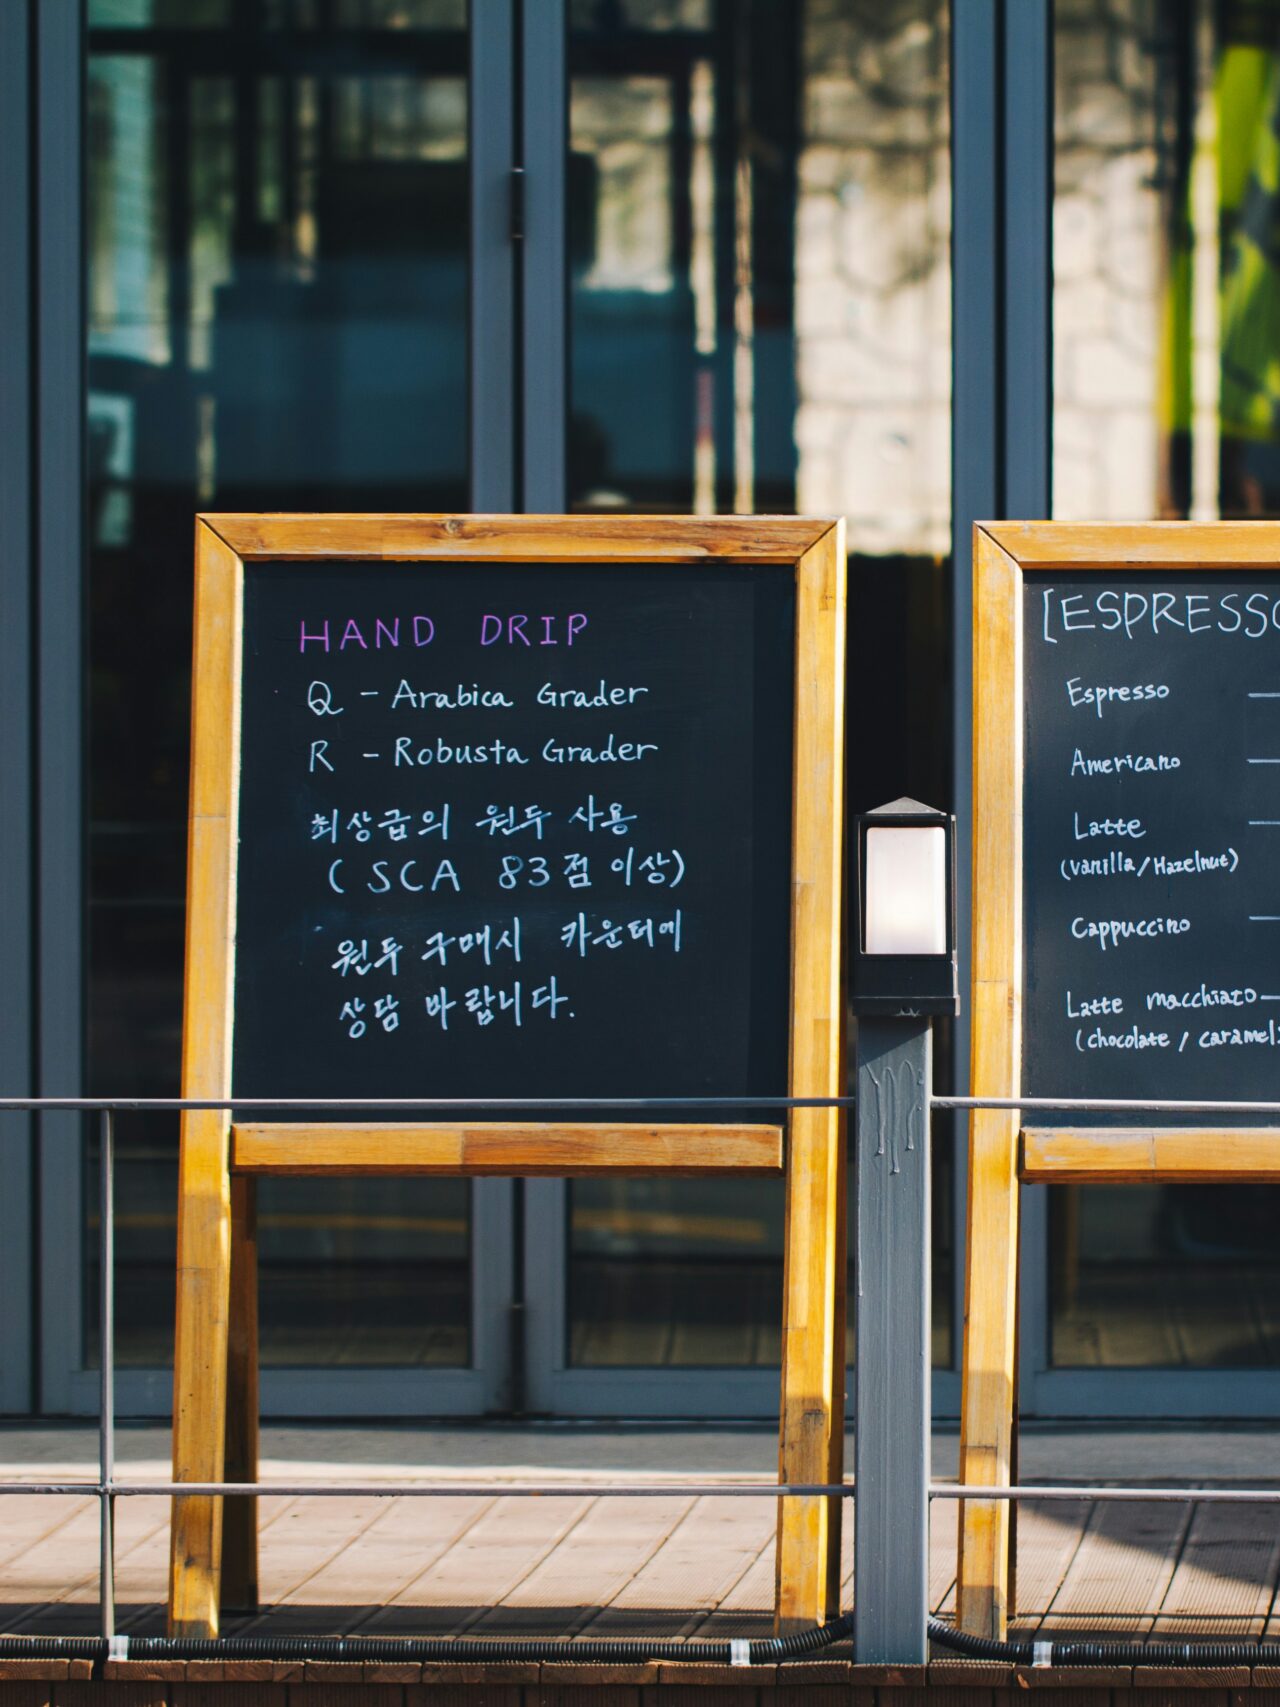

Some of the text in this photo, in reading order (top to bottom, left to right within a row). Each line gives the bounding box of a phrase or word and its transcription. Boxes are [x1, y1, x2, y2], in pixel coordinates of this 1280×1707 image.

[300, 614, 588, 653] HAND DRIP
[308, 681, 344, 716] Q
[391, 679, 513, 708] Arabica
[537, 680, 648, 707] Grader
[1067, 677, 1169, 718] Espresso
[310, 740, 334, 772] R
[395, 737, 529, 766] Robusta
[542, 734, 658, 763] Grader
[1071, 748, 1180, 776] Americano
[311, 795, 637, 843] 최상급의 원두 사용
[1075, 812, 1146, 840] Latte
[611, 847, 685, 887] 이상)
[1071, 917, 1190, 951] Cappuccino
[331, 937, 403, 977] 원두
[339, 994, 399, 1038] 상담
[1067, 991, 1123, 1018] Latte
[1147, 984, 1257, 1010] macchiato
